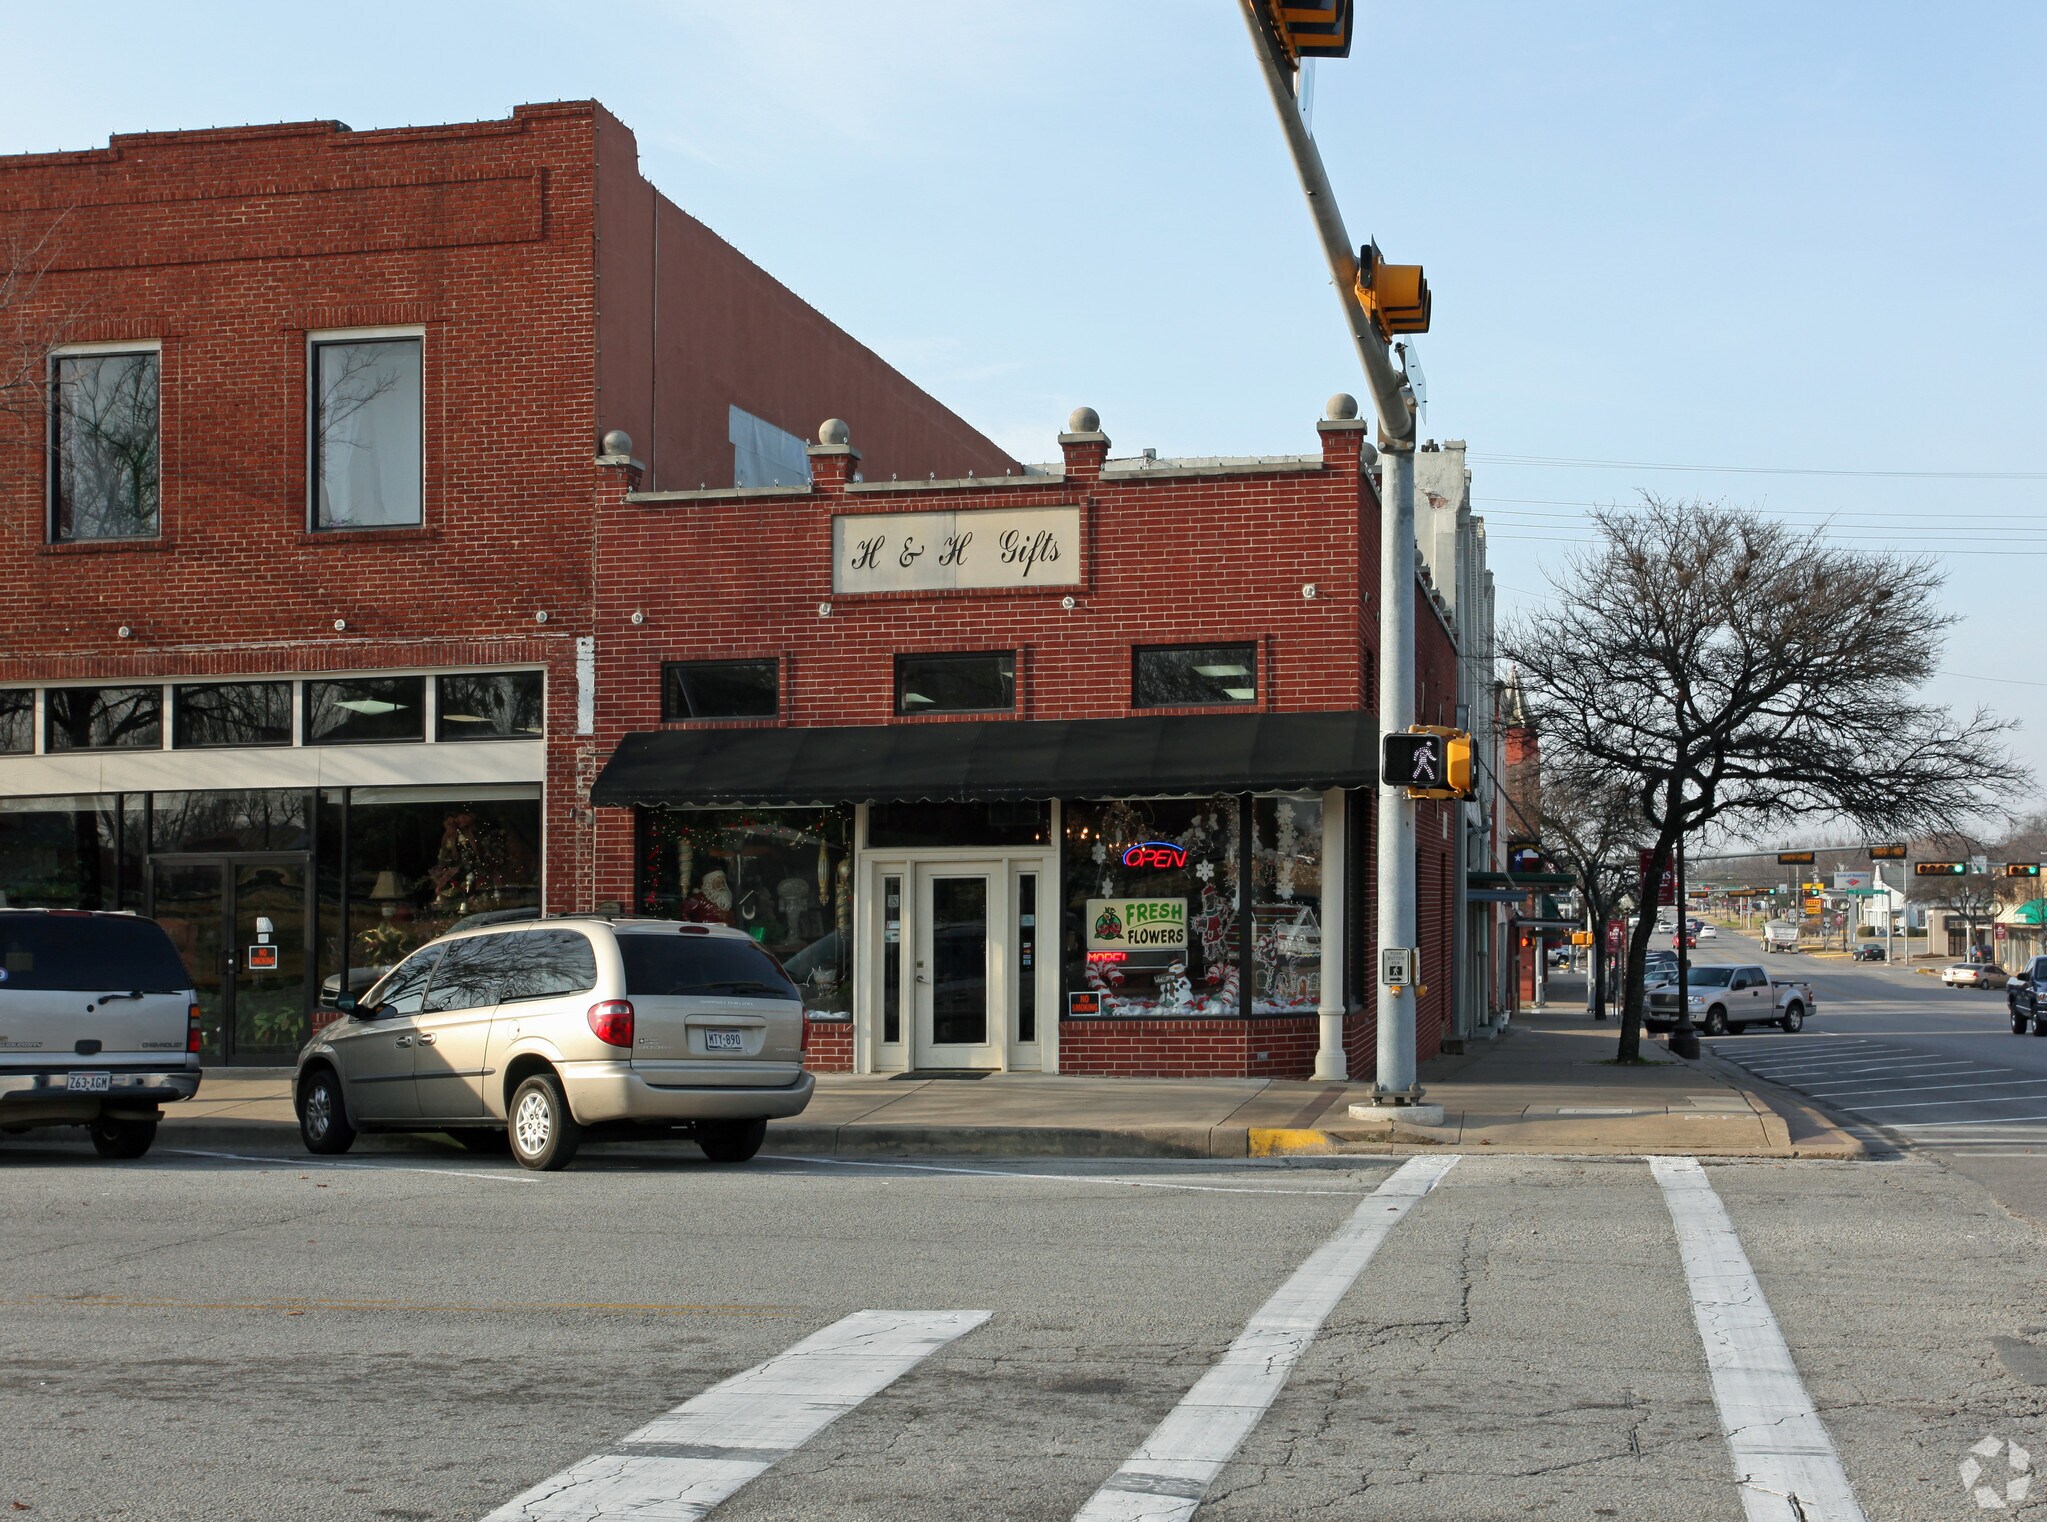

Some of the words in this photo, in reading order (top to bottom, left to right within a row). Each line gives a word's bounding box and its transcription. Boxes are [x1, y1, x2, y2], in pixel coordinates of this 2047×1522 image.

[851, 534, 886, 570] H
[899, 536, 925, 568] &
[938, 531, 974, 566] H
[999, 529, 1062, 578] Gifts
[1125, 849, 1188, 868] OPEN
[1125, 903, 1183, 926] FRESH
[1127, 928, 1184, 944] FLOWERS
[258, 948, 268, 957] NO
[251, 957, 275, 965] SMOKING
[1080, 995, 1089, 1003] NO
[1072, 1003, 1098, 1012] SMOKING
